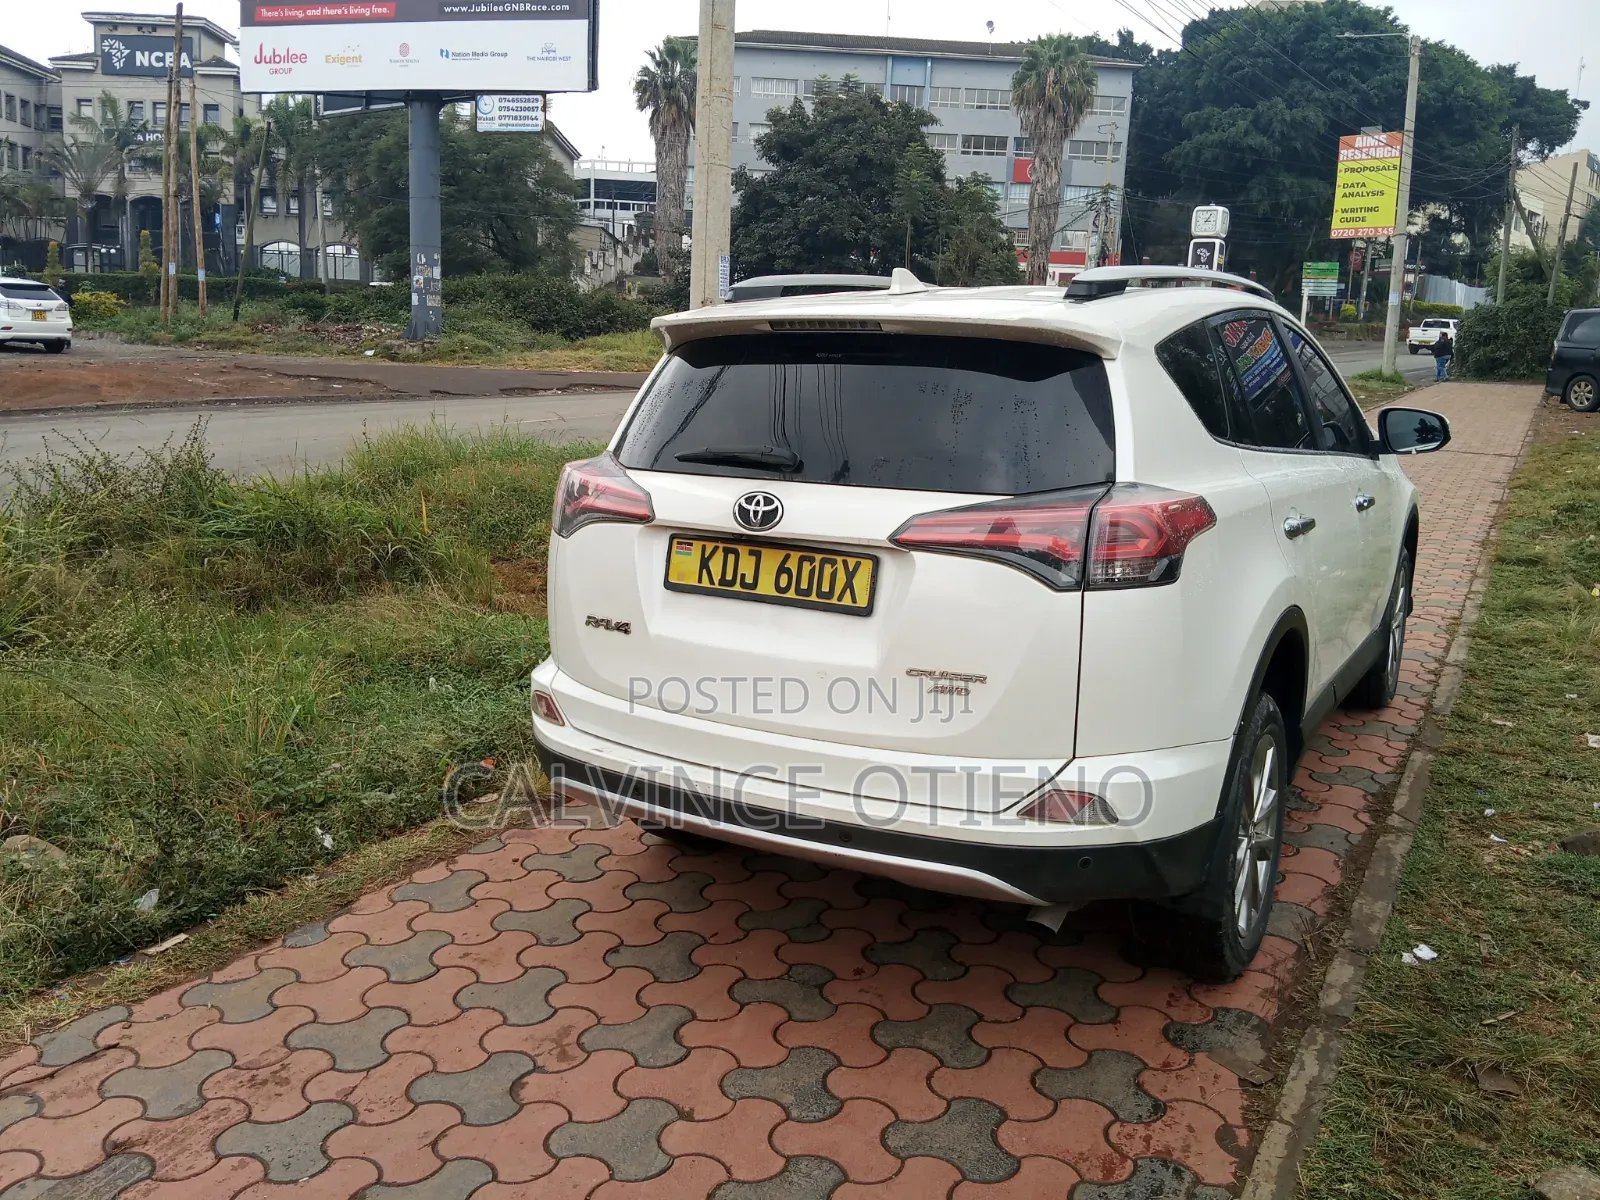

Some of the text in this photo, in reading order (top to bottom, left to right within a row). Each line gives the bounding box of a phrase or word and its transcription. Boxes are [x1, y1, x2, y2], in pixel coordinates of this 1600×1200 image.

[261, 4, 390, 18] There's living, and there's living free.
[444, 3, 570, 12] www.JubileeGNBRace.com
[254, 42, 308, 64] Jubilee
[490, 51, 508, 59] Group
[325, 54, 363, 65] Exigent
[1354, 134, 1388, 148] AIMS
[1340, 145, 1401, 160] RESEARCH
[1344, 164, 1398, 174] PROPOSALS
[1342, 181, 1367, 189] DATA
[1341, 189, 1385, 198] ANALYSIS
[1340, 206, 1380, 214] WRITING
[1331, 227, 1394, 237] 0720 270 345
[697, 543, 763, 591] KDJ
[774, 552, 862, 605] 600X
[585, 614, 632, 635] RAV4
[905, 667, 988, 685] CRUISER
[927, 684, 971, 697] AWD
